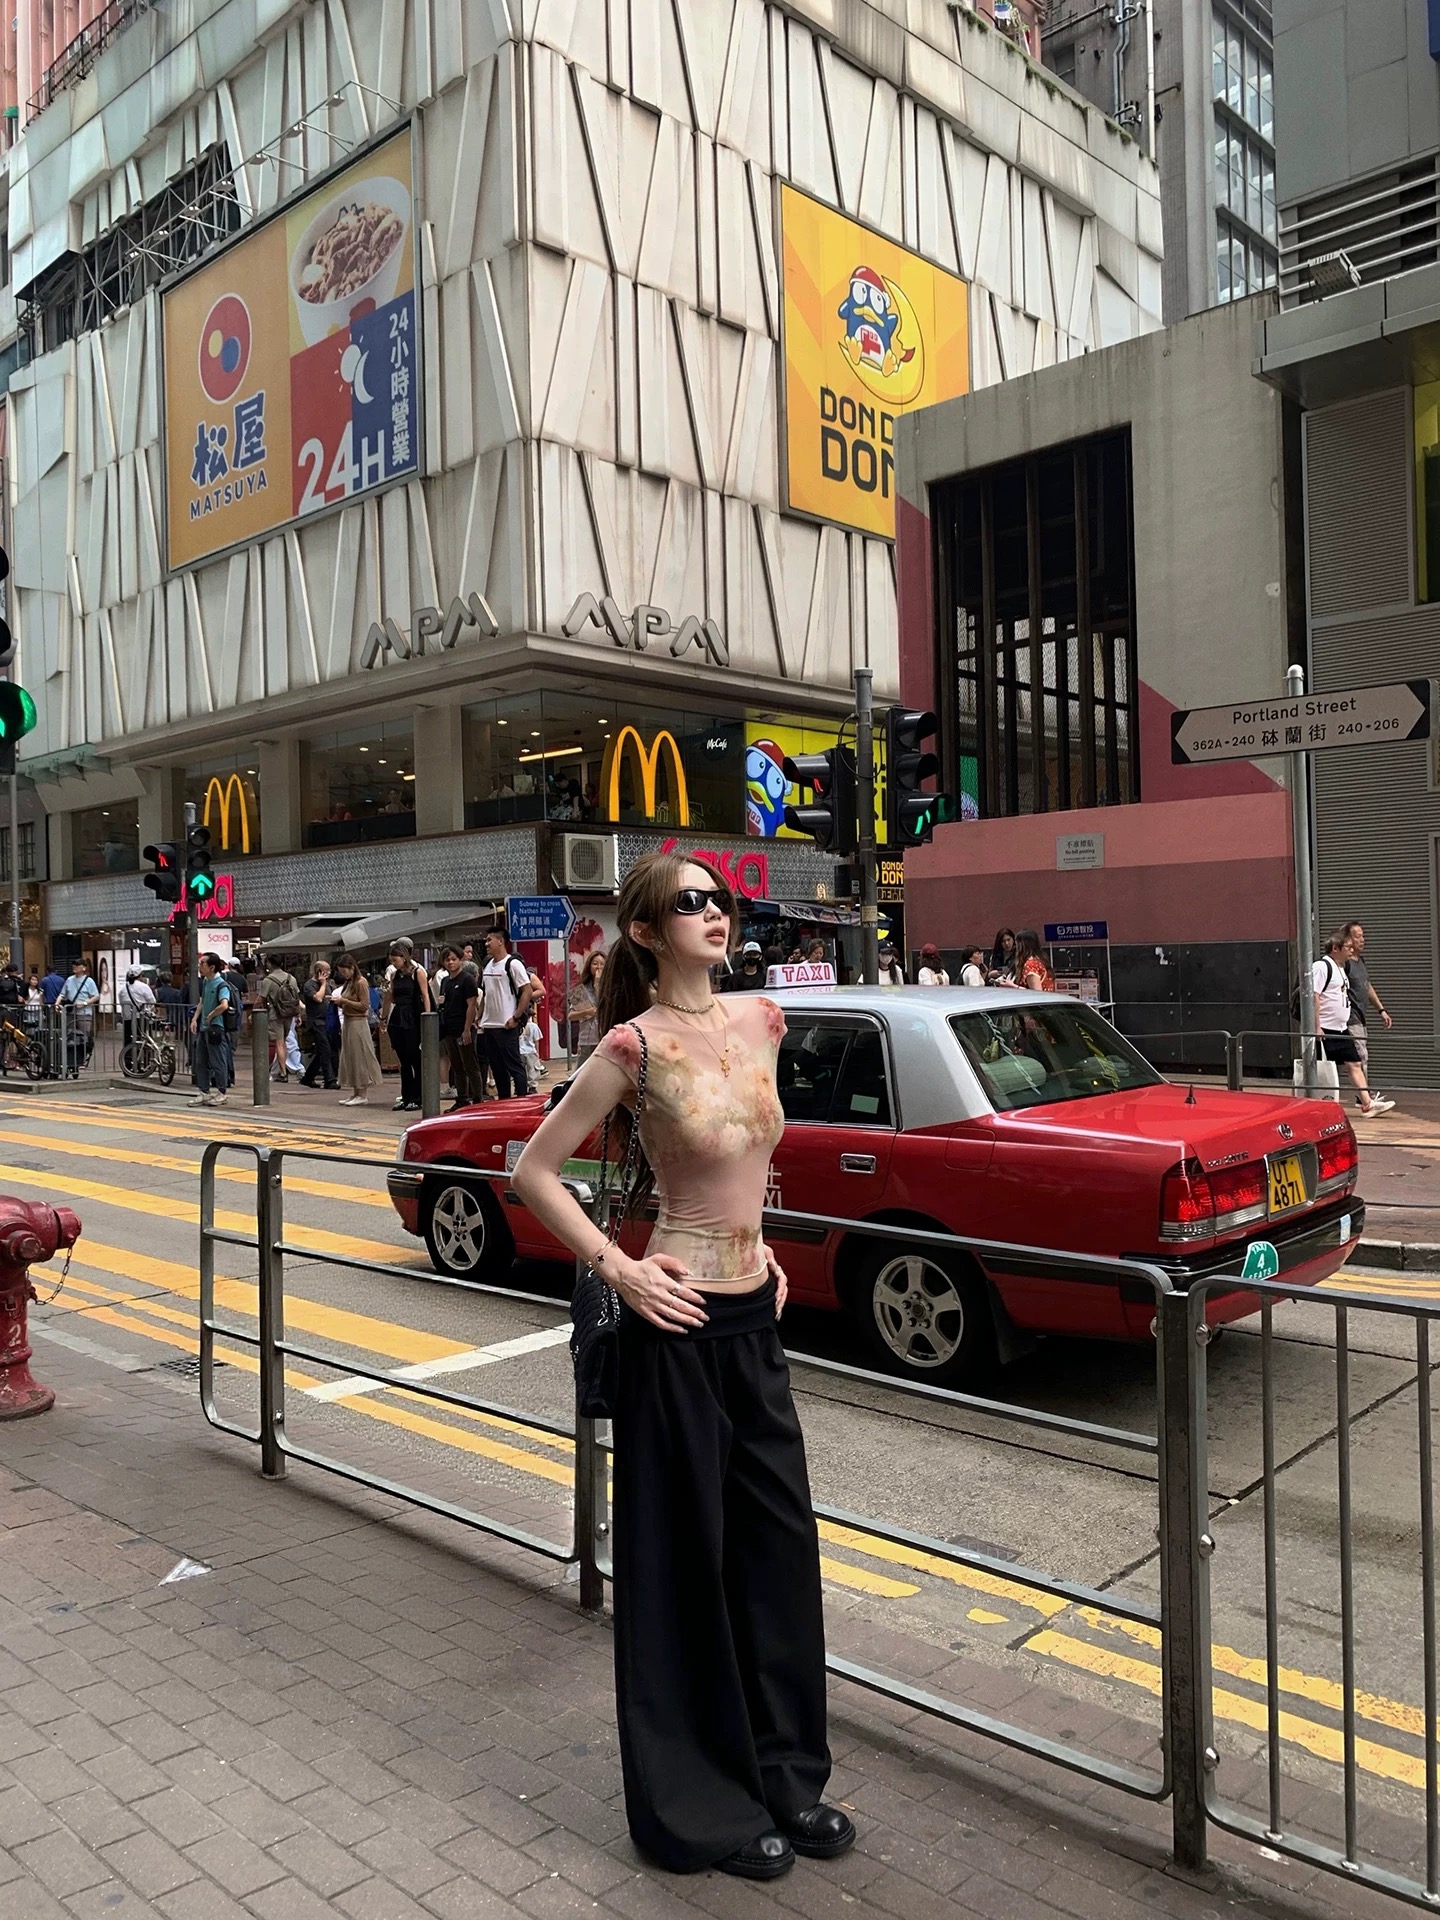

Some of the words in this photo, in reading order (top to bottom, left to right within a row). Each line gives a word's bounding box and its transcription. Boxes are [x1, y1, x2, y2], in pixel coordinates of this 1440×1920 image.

[820, 386, 876, 439] DON
[881, 411, 894, 446] D
[190, 389, 267, 489] 松屋
[190, 468, 268, 521] MATSUYA
[1233, 703, 1299, 725] Portland
[1305, 697, 1357, 716] Street
[881, 861, 895, 871] DON
[881, 870, 904, 885] DON
[519, 900, 539, 908] Subway
[782, 965, 831, 982] TAXI
[1272, 1160, 1288, 1185] UT
[1274, 1180, 1302, 1209] 4871
[1257, 1253, 1265, 1269] 4
